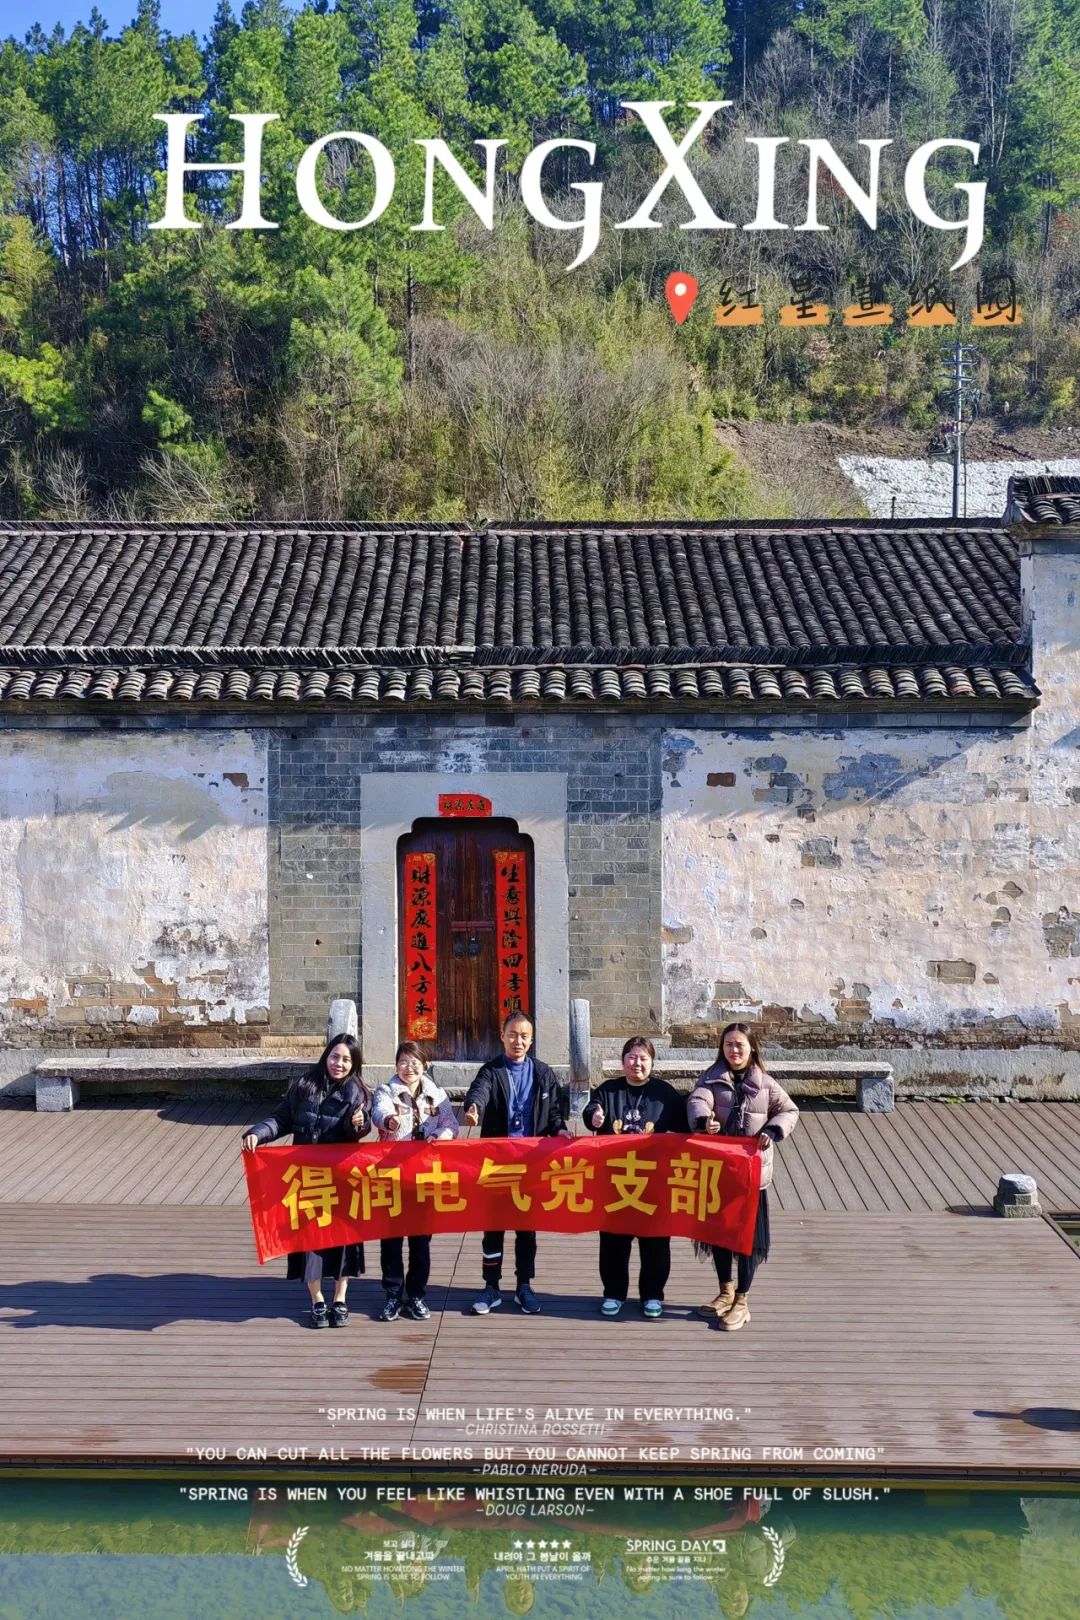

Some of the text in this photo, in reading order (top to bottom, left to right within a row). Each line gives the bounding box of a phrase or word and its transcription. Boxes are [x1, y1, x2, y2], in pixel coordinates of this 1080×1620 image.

[281, 1150, 724, 1230] 得润电气党支部
